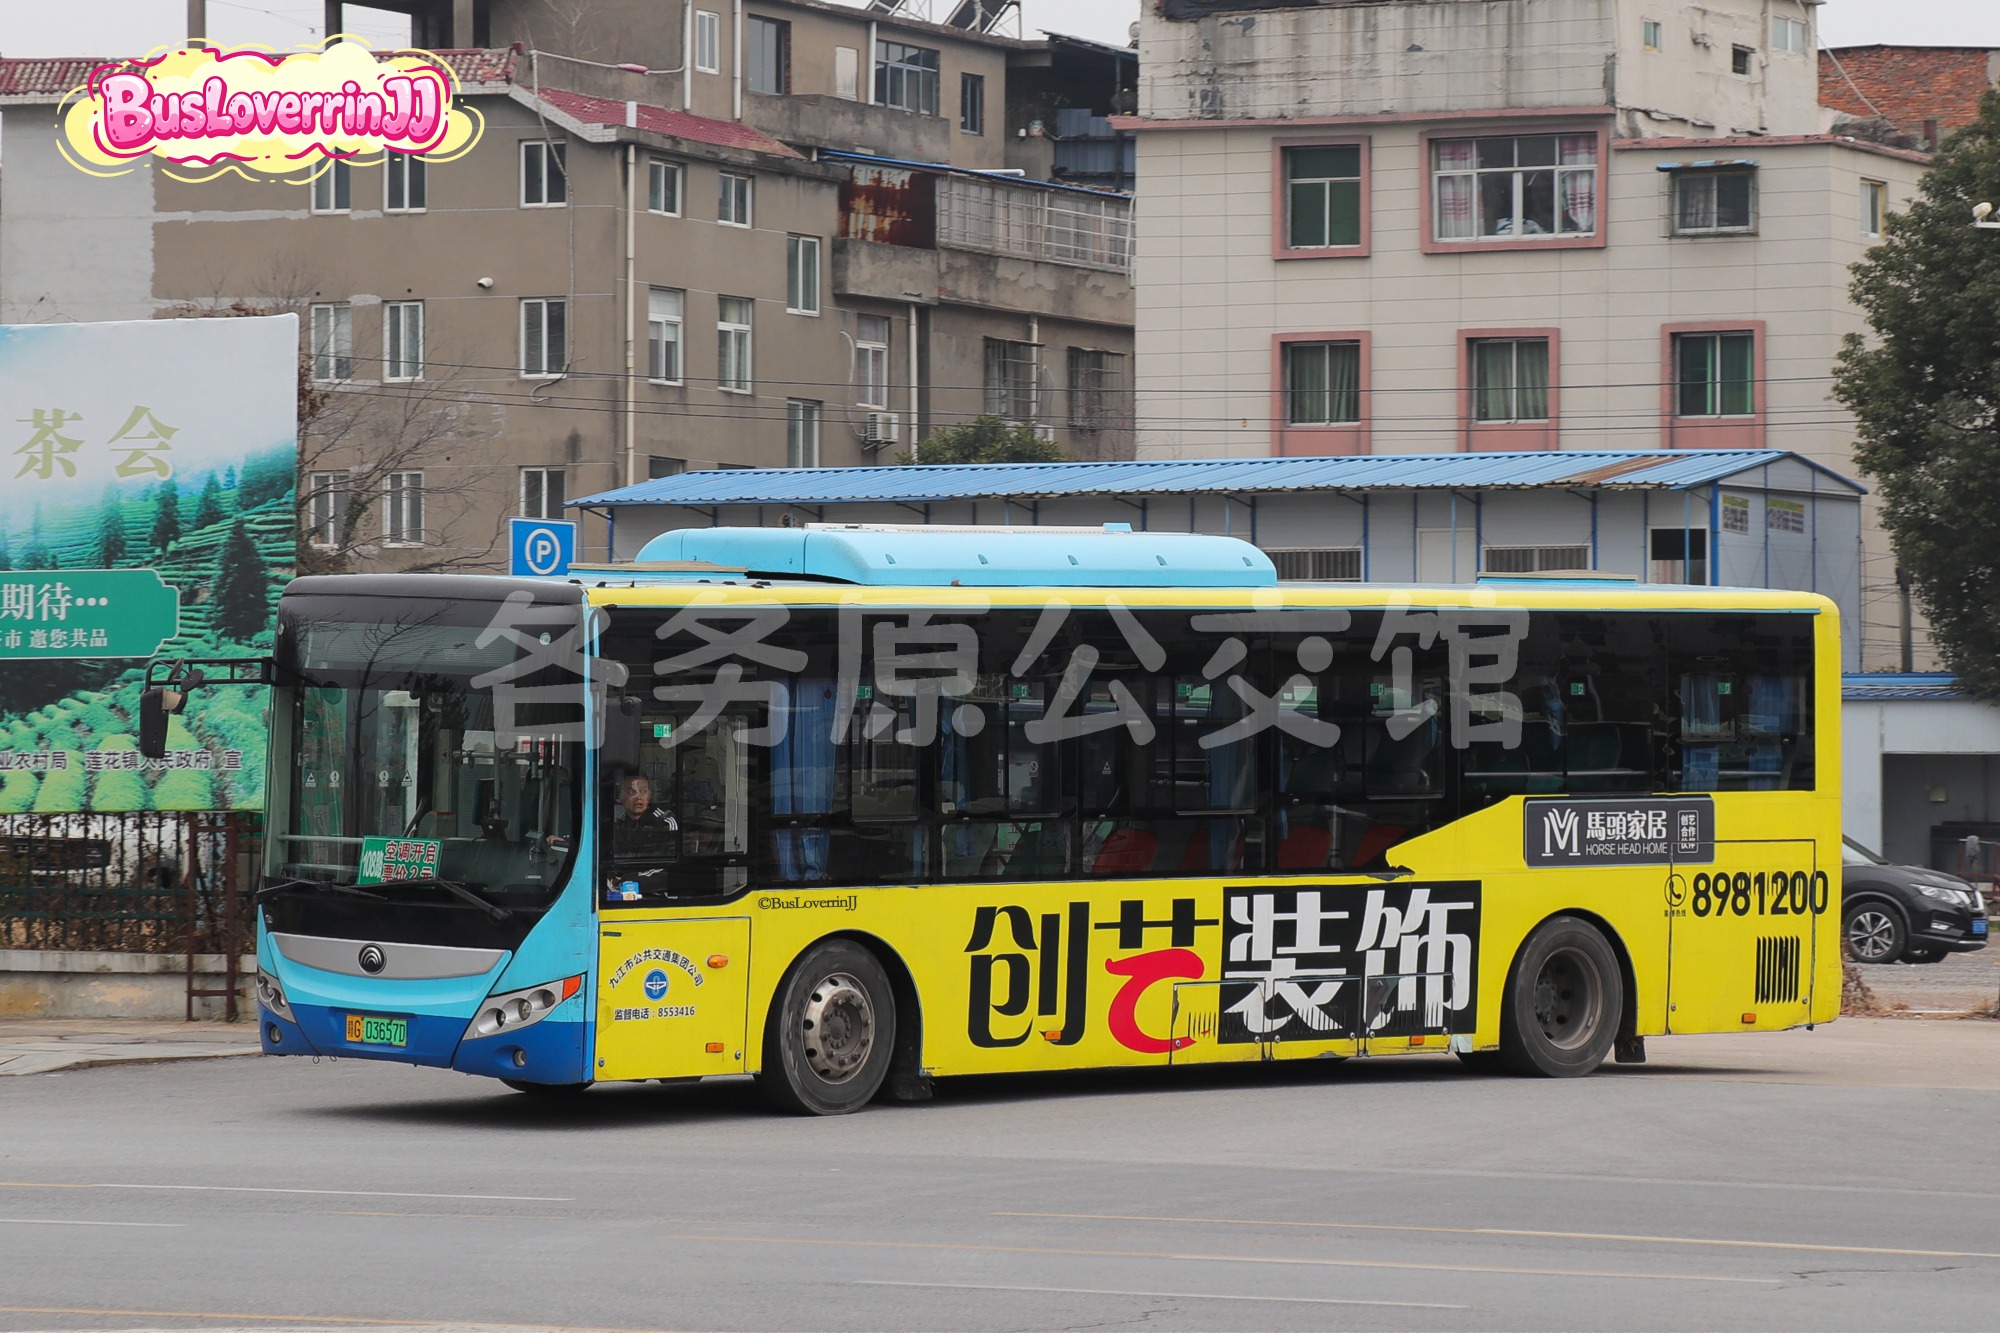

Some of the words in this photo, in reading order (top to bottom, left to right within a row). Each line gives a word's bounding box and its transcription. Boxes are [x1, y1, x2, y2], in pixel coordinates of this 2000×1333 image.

[12, 405, 181, 480] 茶会
[536, 540, 551, 563] P
[28, 628, 109, 649] 邀您共品
[224, 751, 243, 770] 宣
[1586, 810, 1667, 841] 馬頭家居
[384, 841, 437, 864] 空调开启
[1585, 843, 1616, 856] HORSE
[1618, 843, 1641, 855] HEAD
[1643, 842, 1668, 855] HOME
[1692, 870, 1829, 918] 8981200
[608, 948, 705, 989] 九江市公共交通集团公司
[964, 888, 1475, 1054] 创艺装饰
